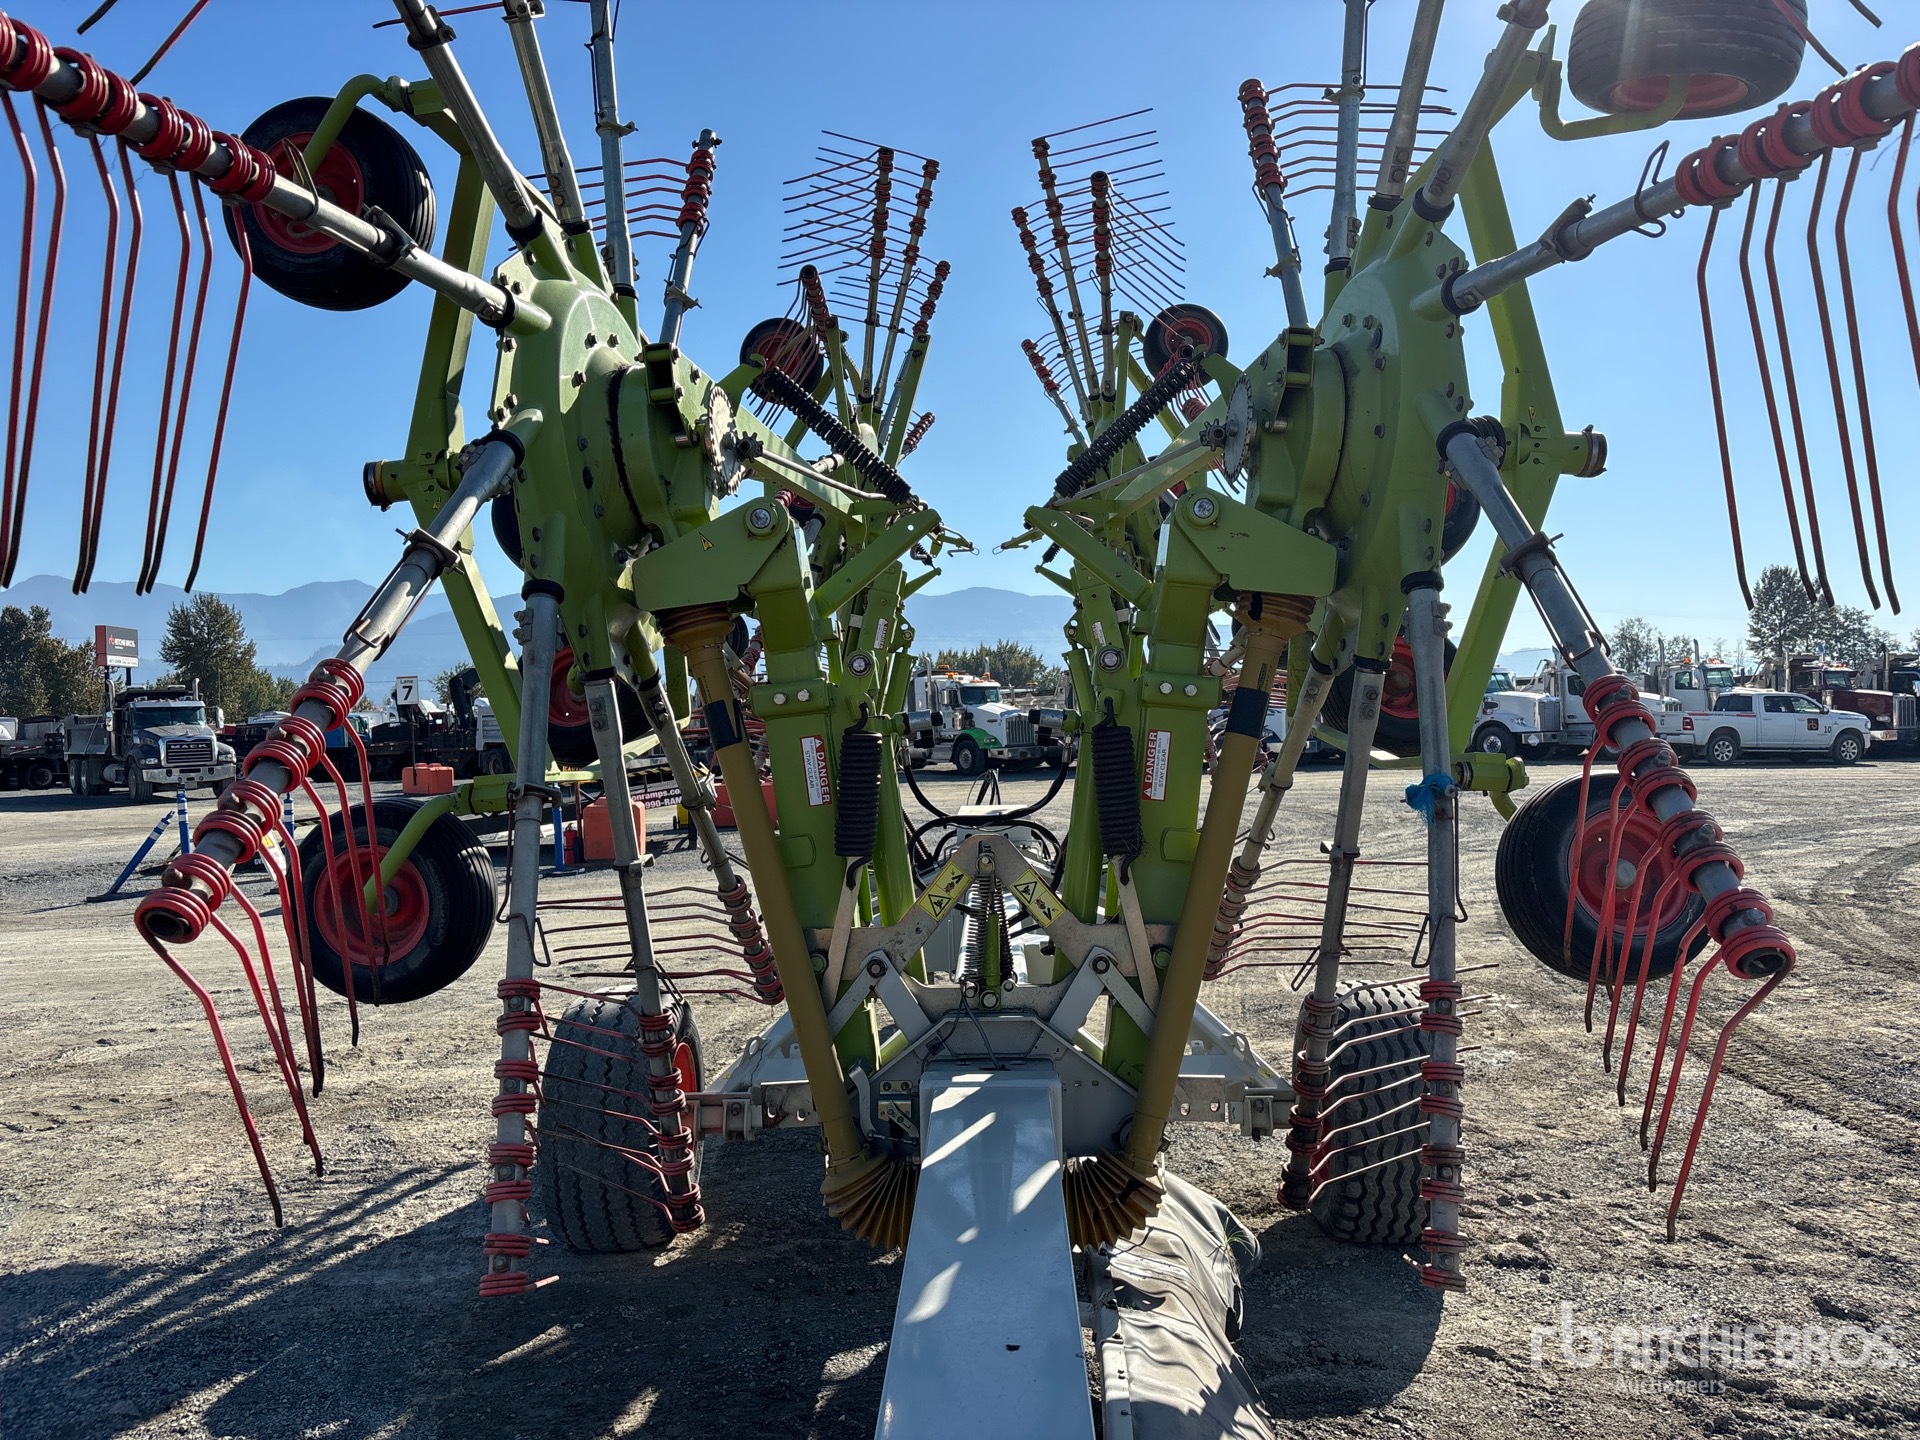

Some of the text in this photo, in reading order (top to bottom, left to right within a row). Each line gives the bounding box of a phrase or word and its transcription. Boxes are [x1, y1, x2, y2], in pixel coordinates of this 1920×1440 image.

[402, 685, 413, 701] 7
[1145, 732, 1157, 783] DANGER
[816, 752, 830, 802] DANGER
[631, 789, 680, 801] onramps.co
